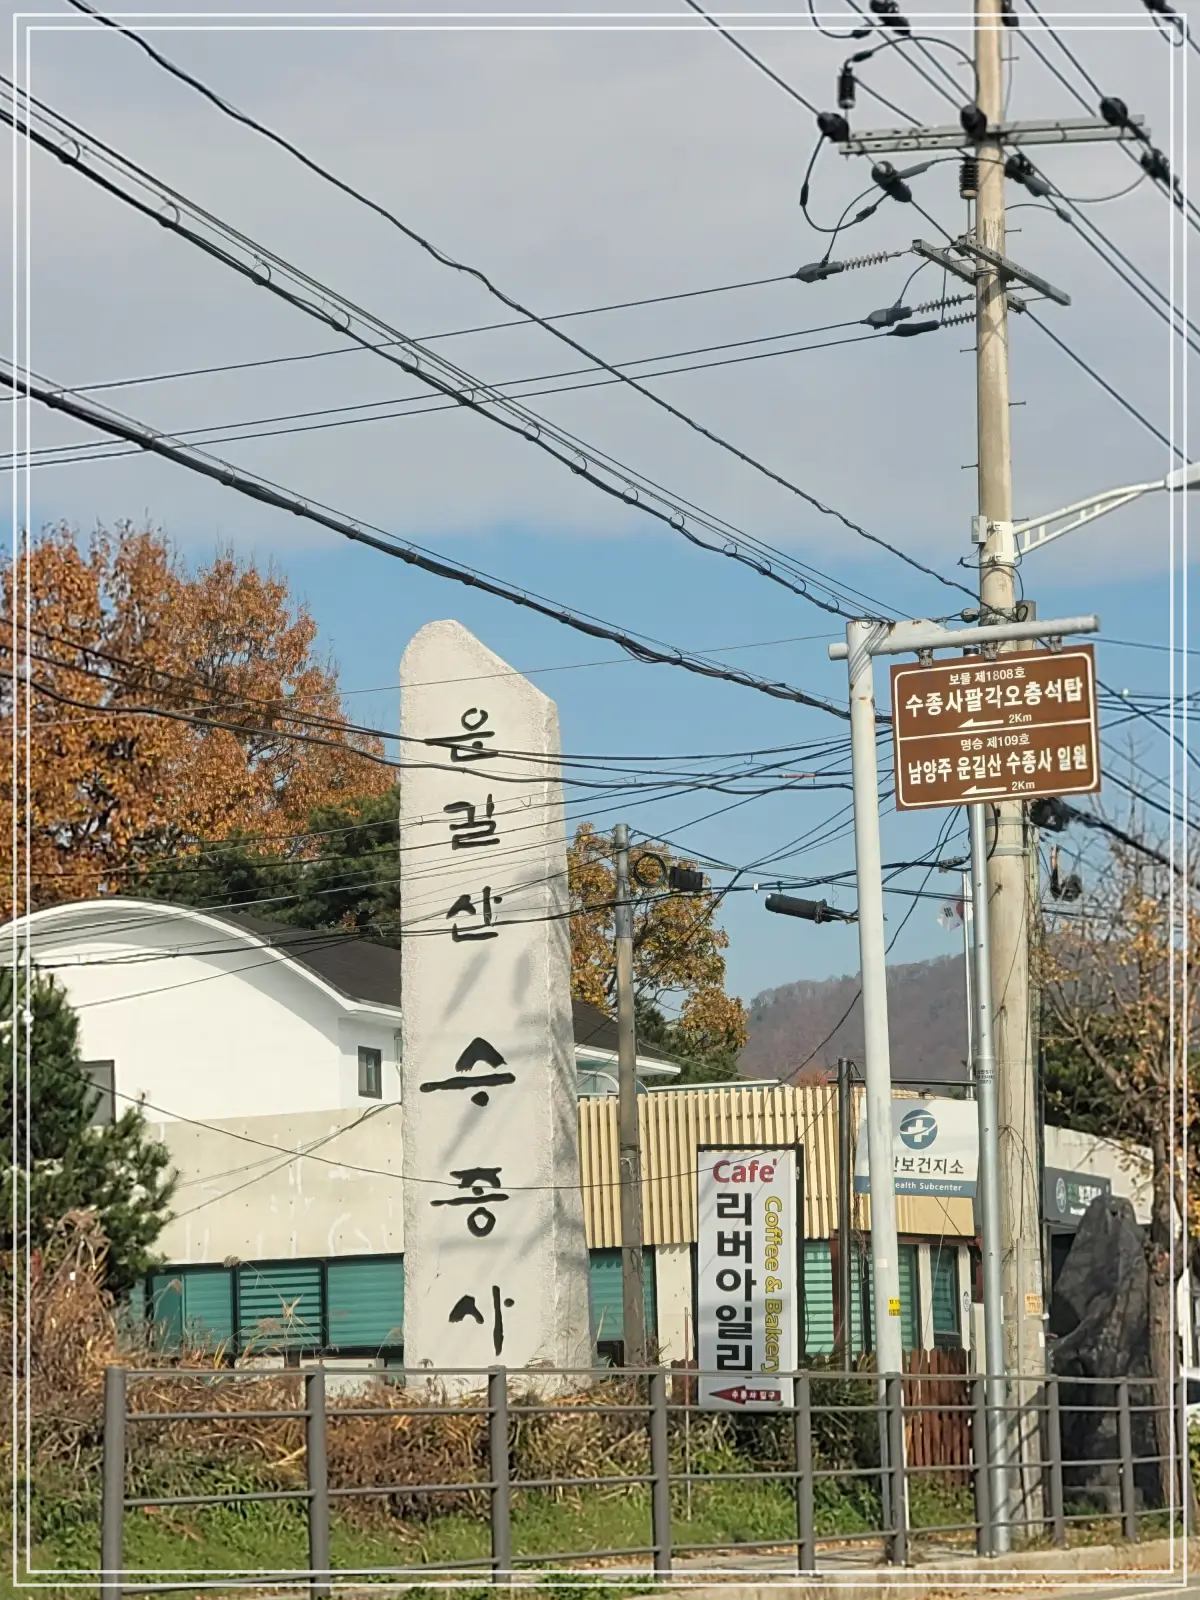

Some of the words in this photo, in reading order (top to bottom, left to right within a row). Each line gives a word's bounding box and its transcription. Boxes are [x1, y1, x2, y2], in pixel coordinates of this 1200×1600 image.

[949, 673, 972, 686] 보물
[974, 666, 1027, 683] 제1808호
[905, 676, 1083, 717] 수종사팔각오층석탑
[1008, 712, 1033, 724] 2Km
[960, 737, 984, 751] 명승
[986, 733, 1031, 749] 제109호
[908, 757, 953, 785] 남양주
[956, 753, 1002, 780] 운길산
[1006, 747, 1053, 775] 수종사
[1057, 743, 1088, 771] 일원
[1011, 780, 1036, 791] 2Km
[895, 1181, 917, 1189] ealth
[919, 1182, 963, 1191] Subcenter
[419, 1037, 516, 1356] 수종사
[764, 1195, 782, 1272] Coffee
[764, 1275, 782, 1293] &
[761, 1298, 783, 1379] Bakery
